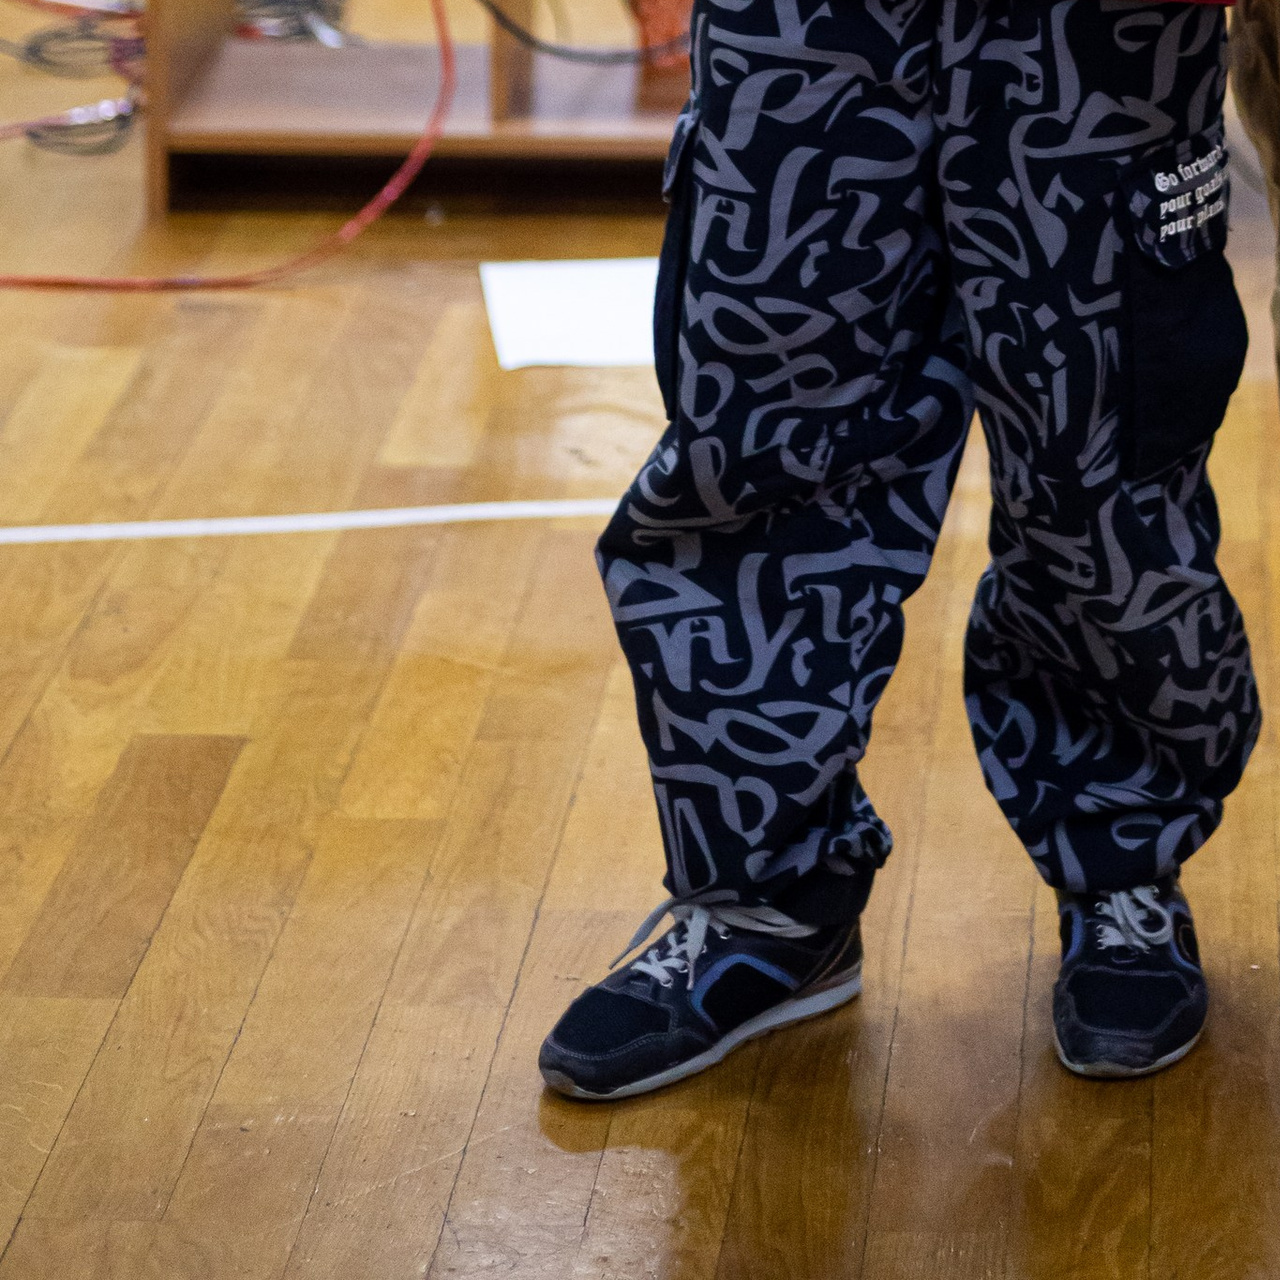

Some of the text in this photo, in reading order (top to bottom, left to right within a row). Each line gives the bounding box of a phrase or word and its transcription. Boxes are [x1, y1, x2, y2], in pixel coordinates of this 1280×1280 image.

[1154, 172, 1179, 192] Go
[1160, 192, 1193, 219] your
[1160, 216, 1194, 242] your
